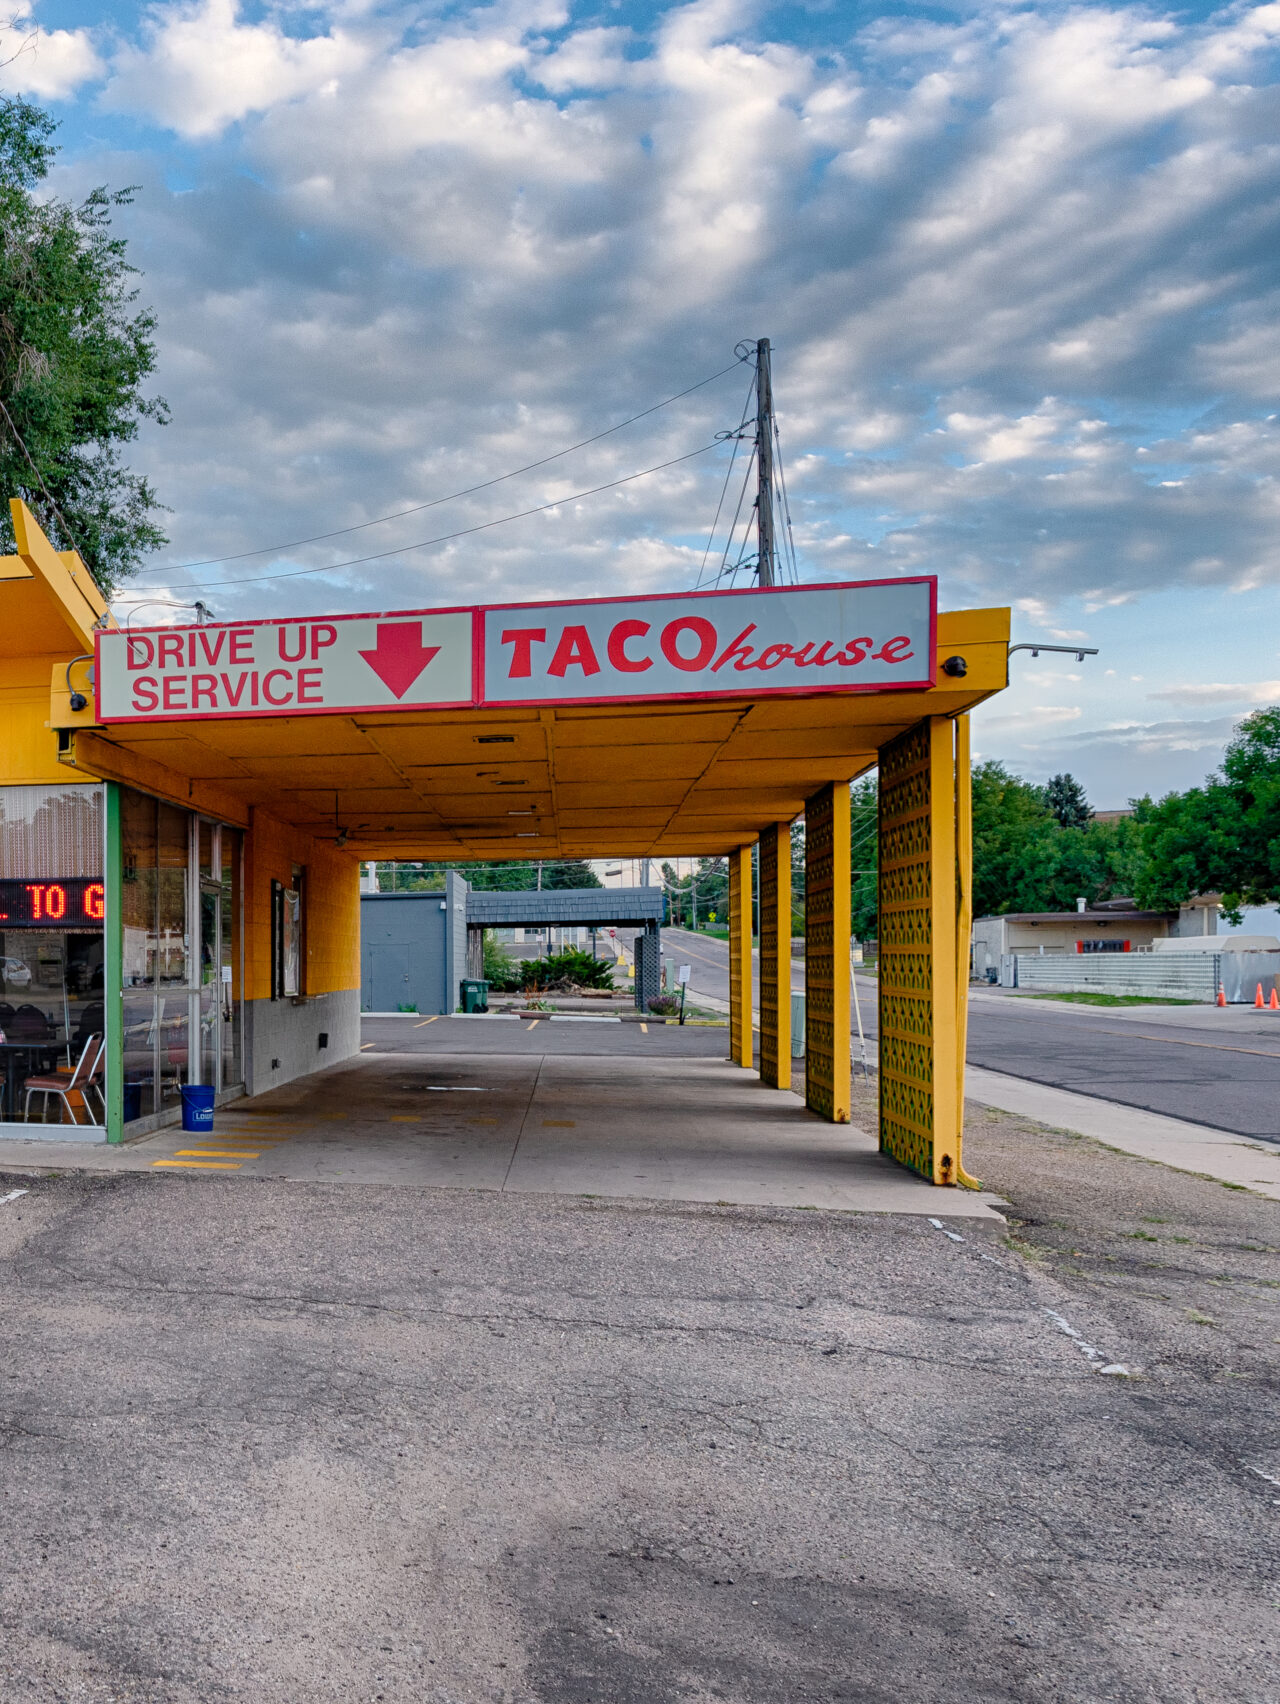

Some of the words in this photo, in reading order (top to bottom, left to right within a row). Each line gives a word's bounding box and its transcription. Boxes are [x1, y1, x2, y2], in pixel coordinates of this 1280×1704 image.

[126, 629, 256, 671] DRIVE
[278, 624, 338, 662] UP
[501, 616, 718, 678] TACO
[710, 623, 915, 673] house
[131, 667, 324, 712] SERVICE
[26, 885, 66, 919] TO
